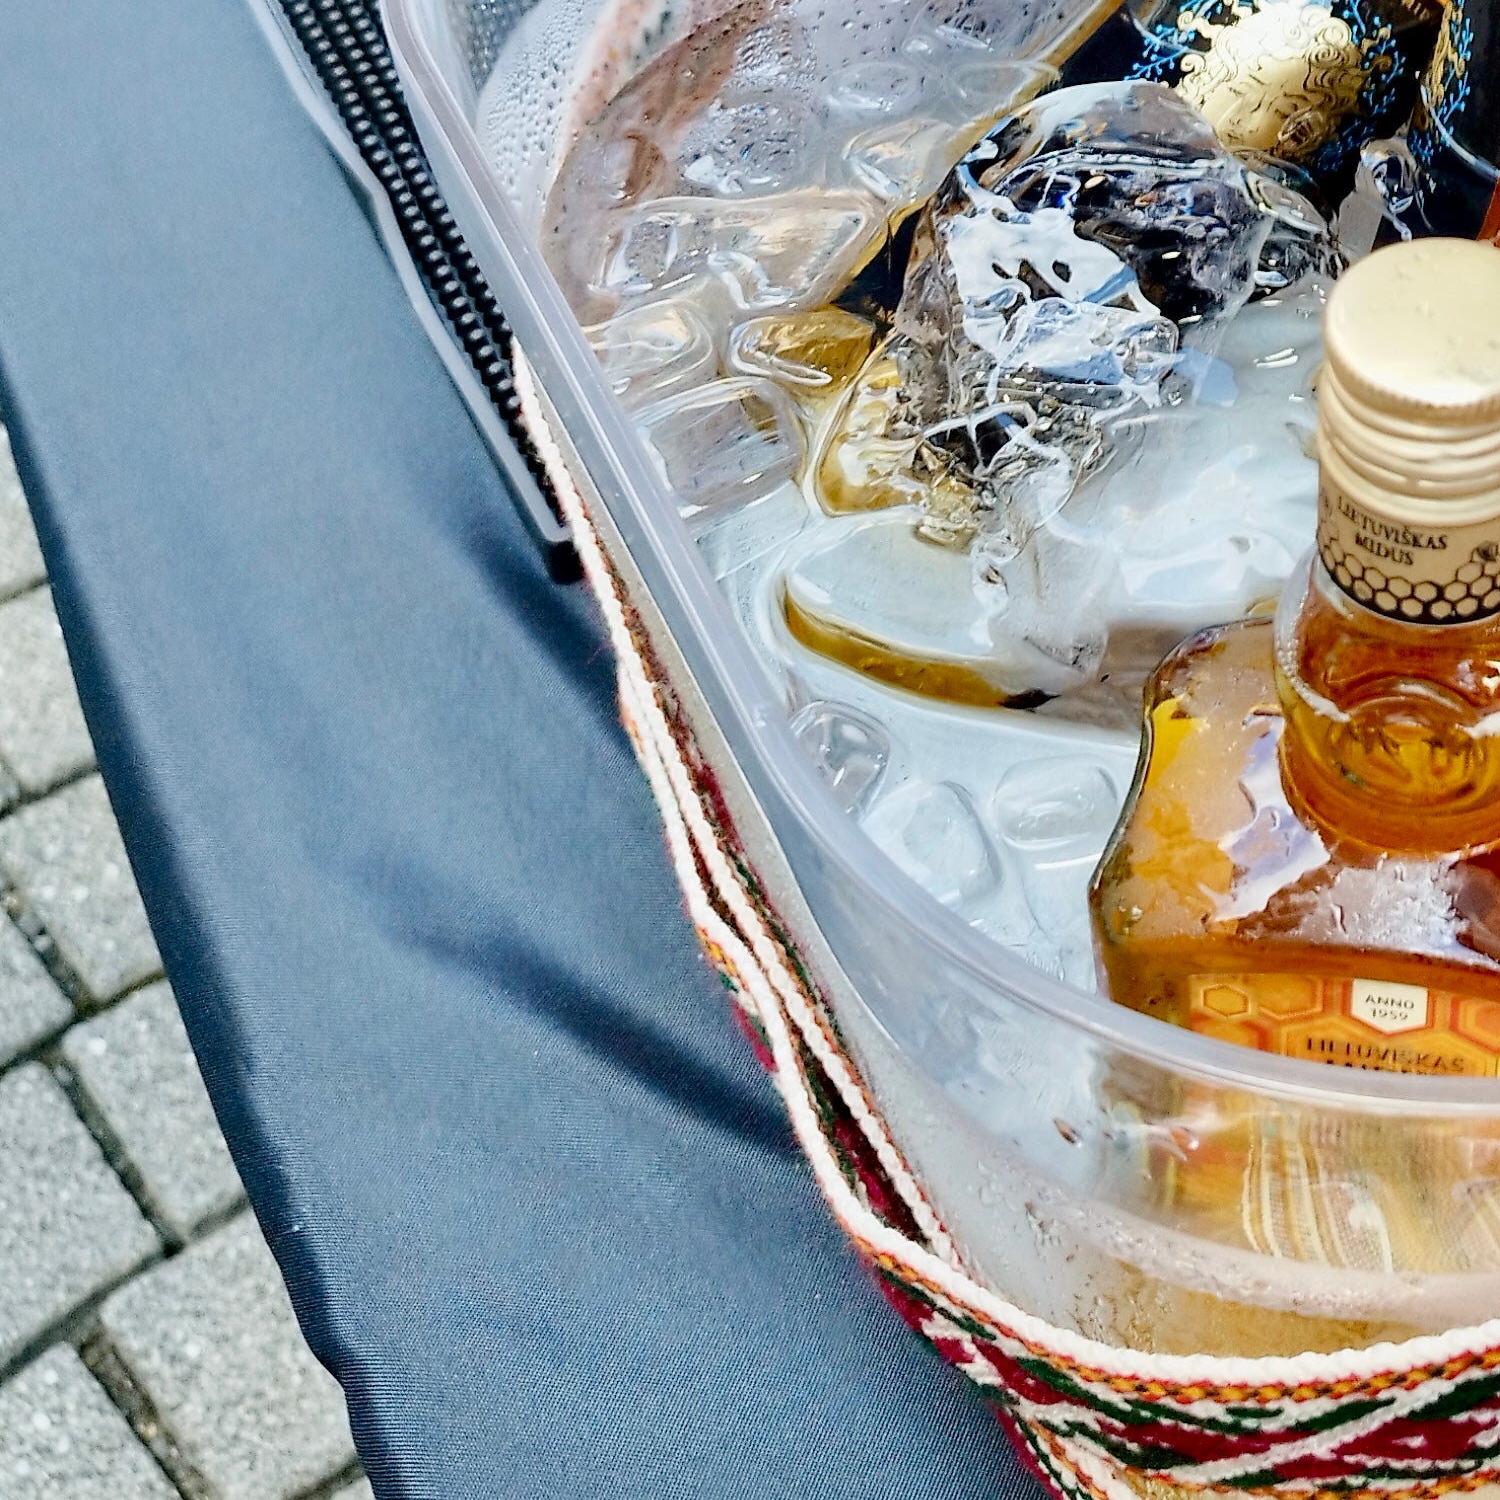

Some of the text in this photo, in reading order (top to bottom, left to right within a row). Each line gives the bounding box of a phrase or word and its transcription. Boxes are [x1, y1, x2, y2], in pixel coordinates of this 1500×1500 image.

[1356, 533, 1415, 565] MIDUS
[1365, 994, 1415, 1009] ANNO
[1370, 1008, 1409, 1021] 1959
